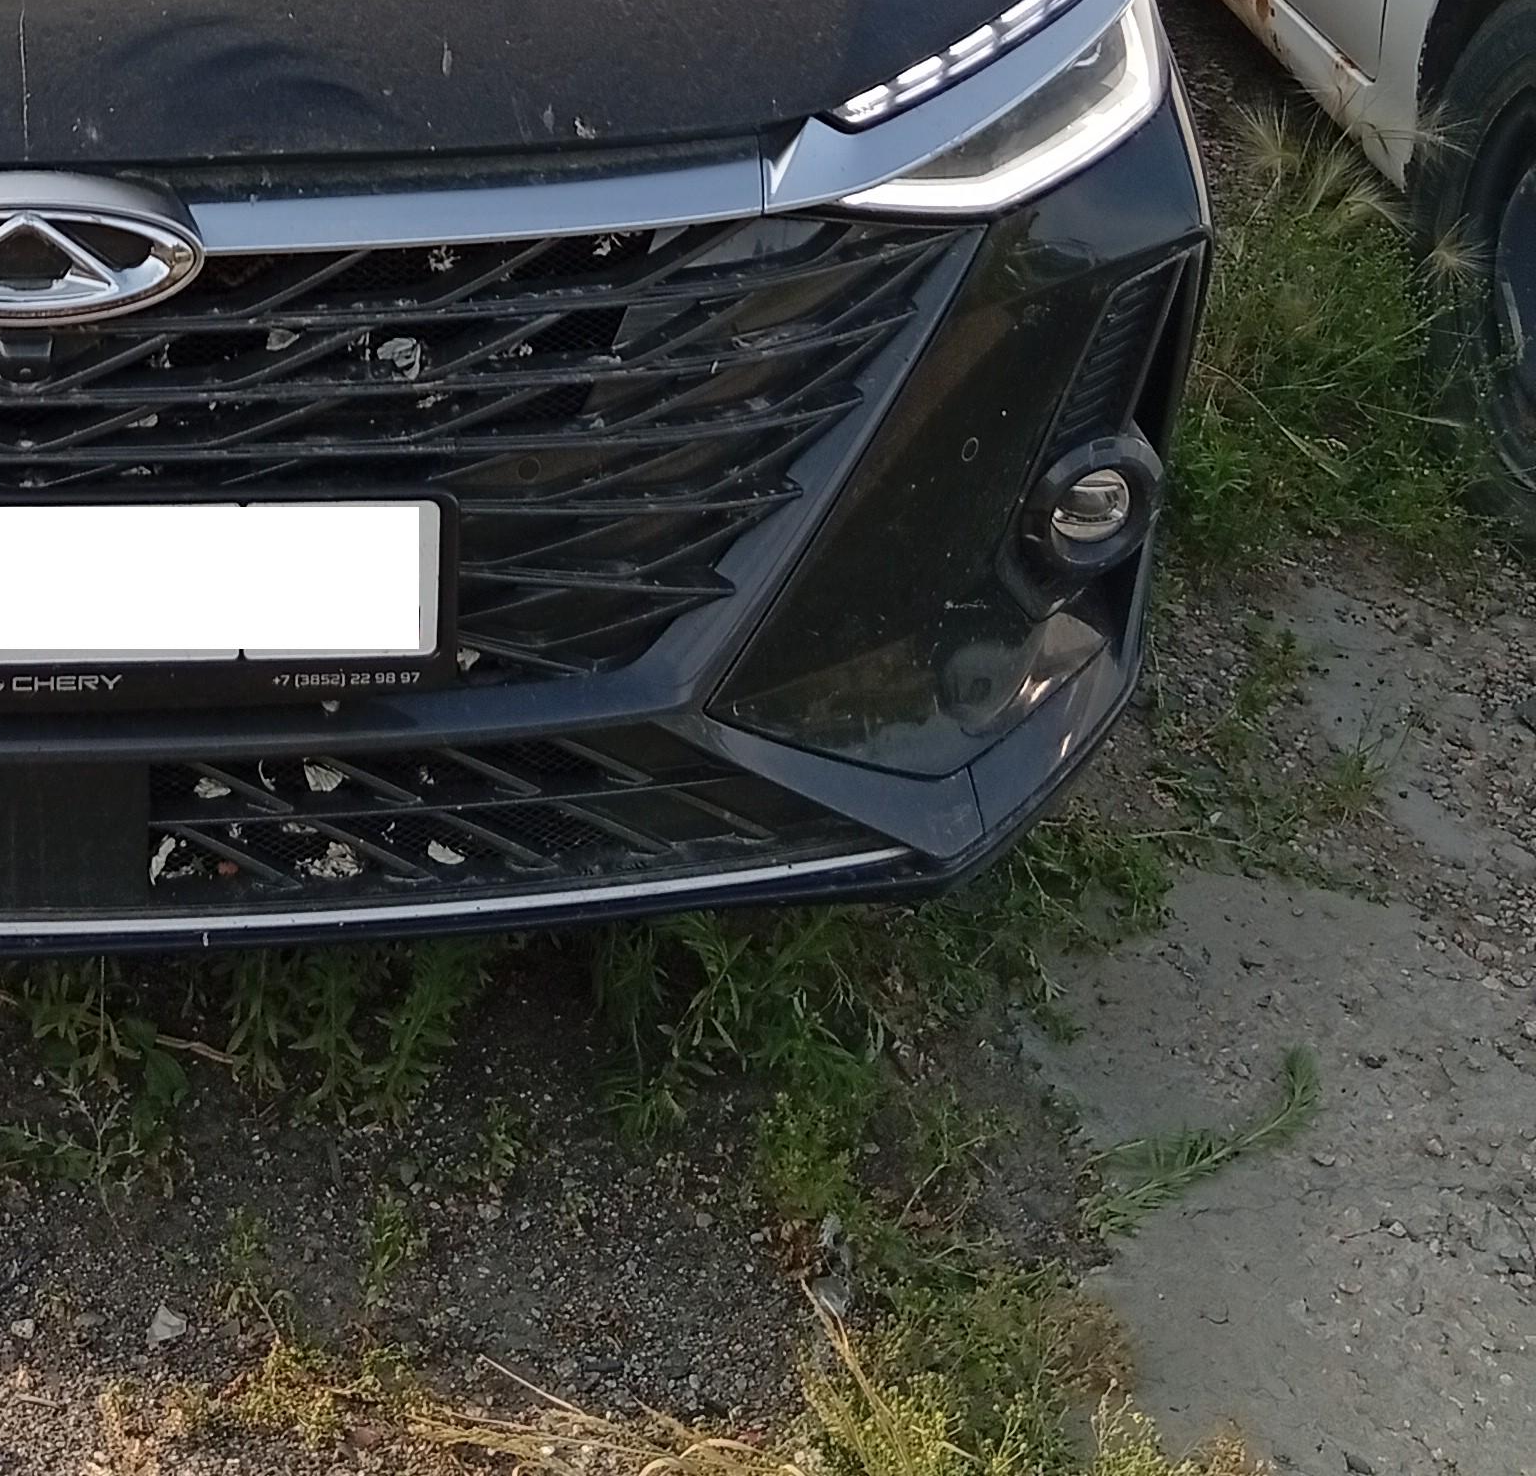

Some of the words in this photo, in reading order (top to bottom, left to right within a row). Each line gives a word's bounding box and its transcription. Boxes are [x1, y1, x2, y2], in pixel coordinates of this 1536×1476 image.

[12, 674, 123, 692] CHERY
[272, 674, 290, 687] +7
[294, 672, 346, 688] (3852)
[350, 672, 370, 685] 22
[375, 672, 396, 684] 98
[400, 671, 421, 684] 97
